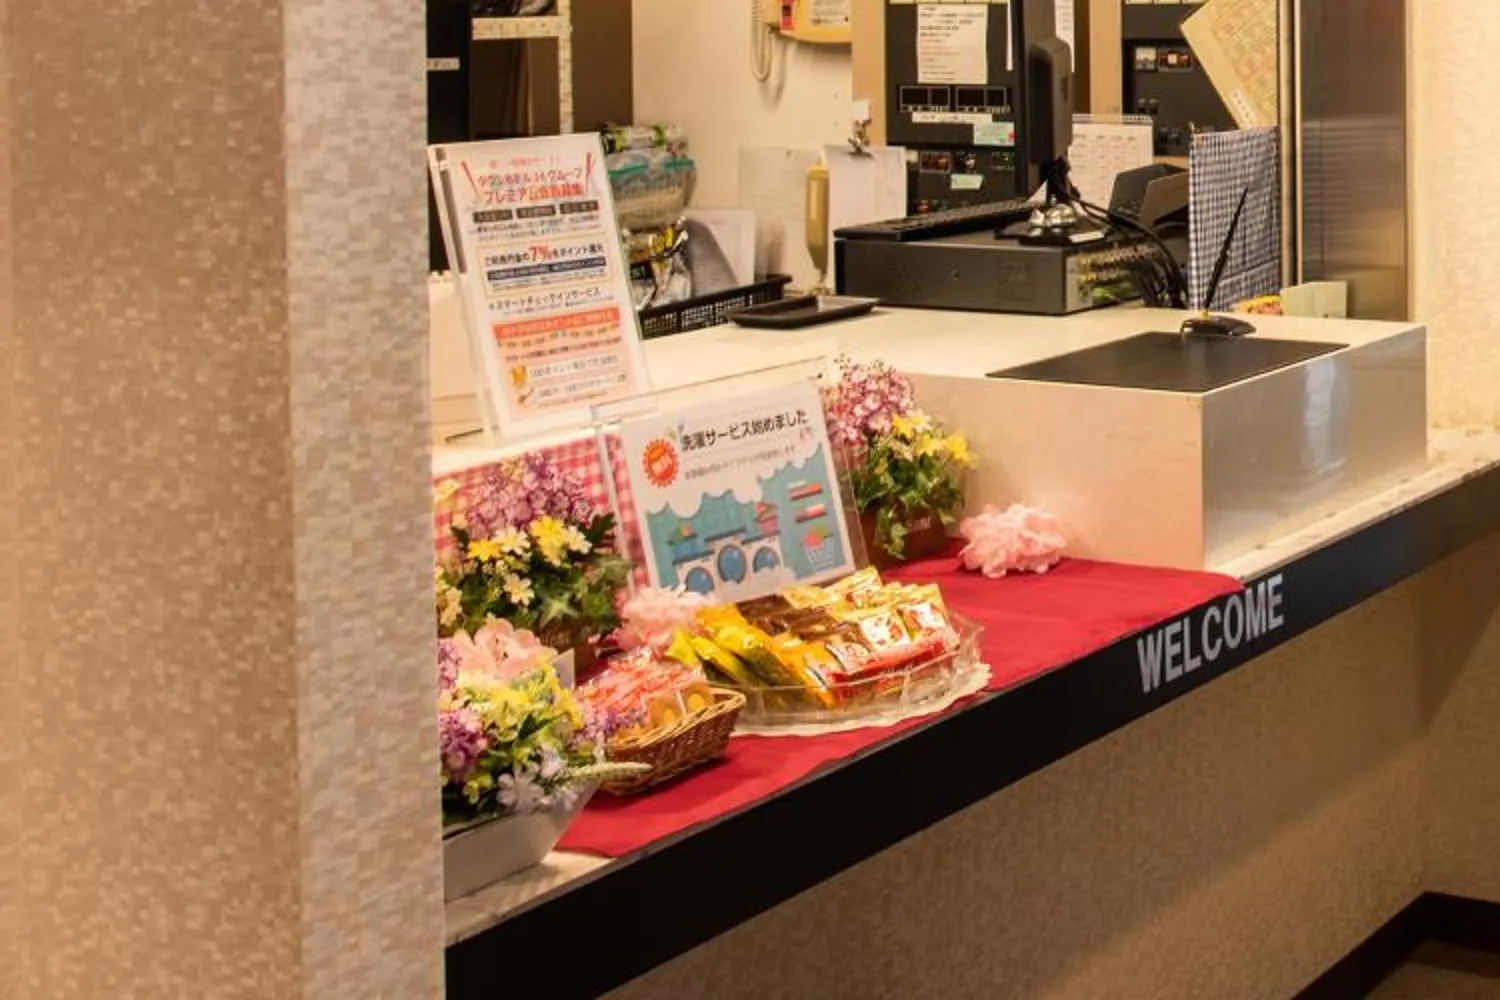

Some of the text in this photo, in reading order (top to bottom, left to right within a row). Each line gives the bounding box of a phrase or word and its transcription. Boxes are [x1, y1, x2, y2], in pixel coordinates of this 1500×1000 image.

[681, 409, 809, 452] 洗濯サービス始めました
[1137, 574, 1284, 693] WELCOME
